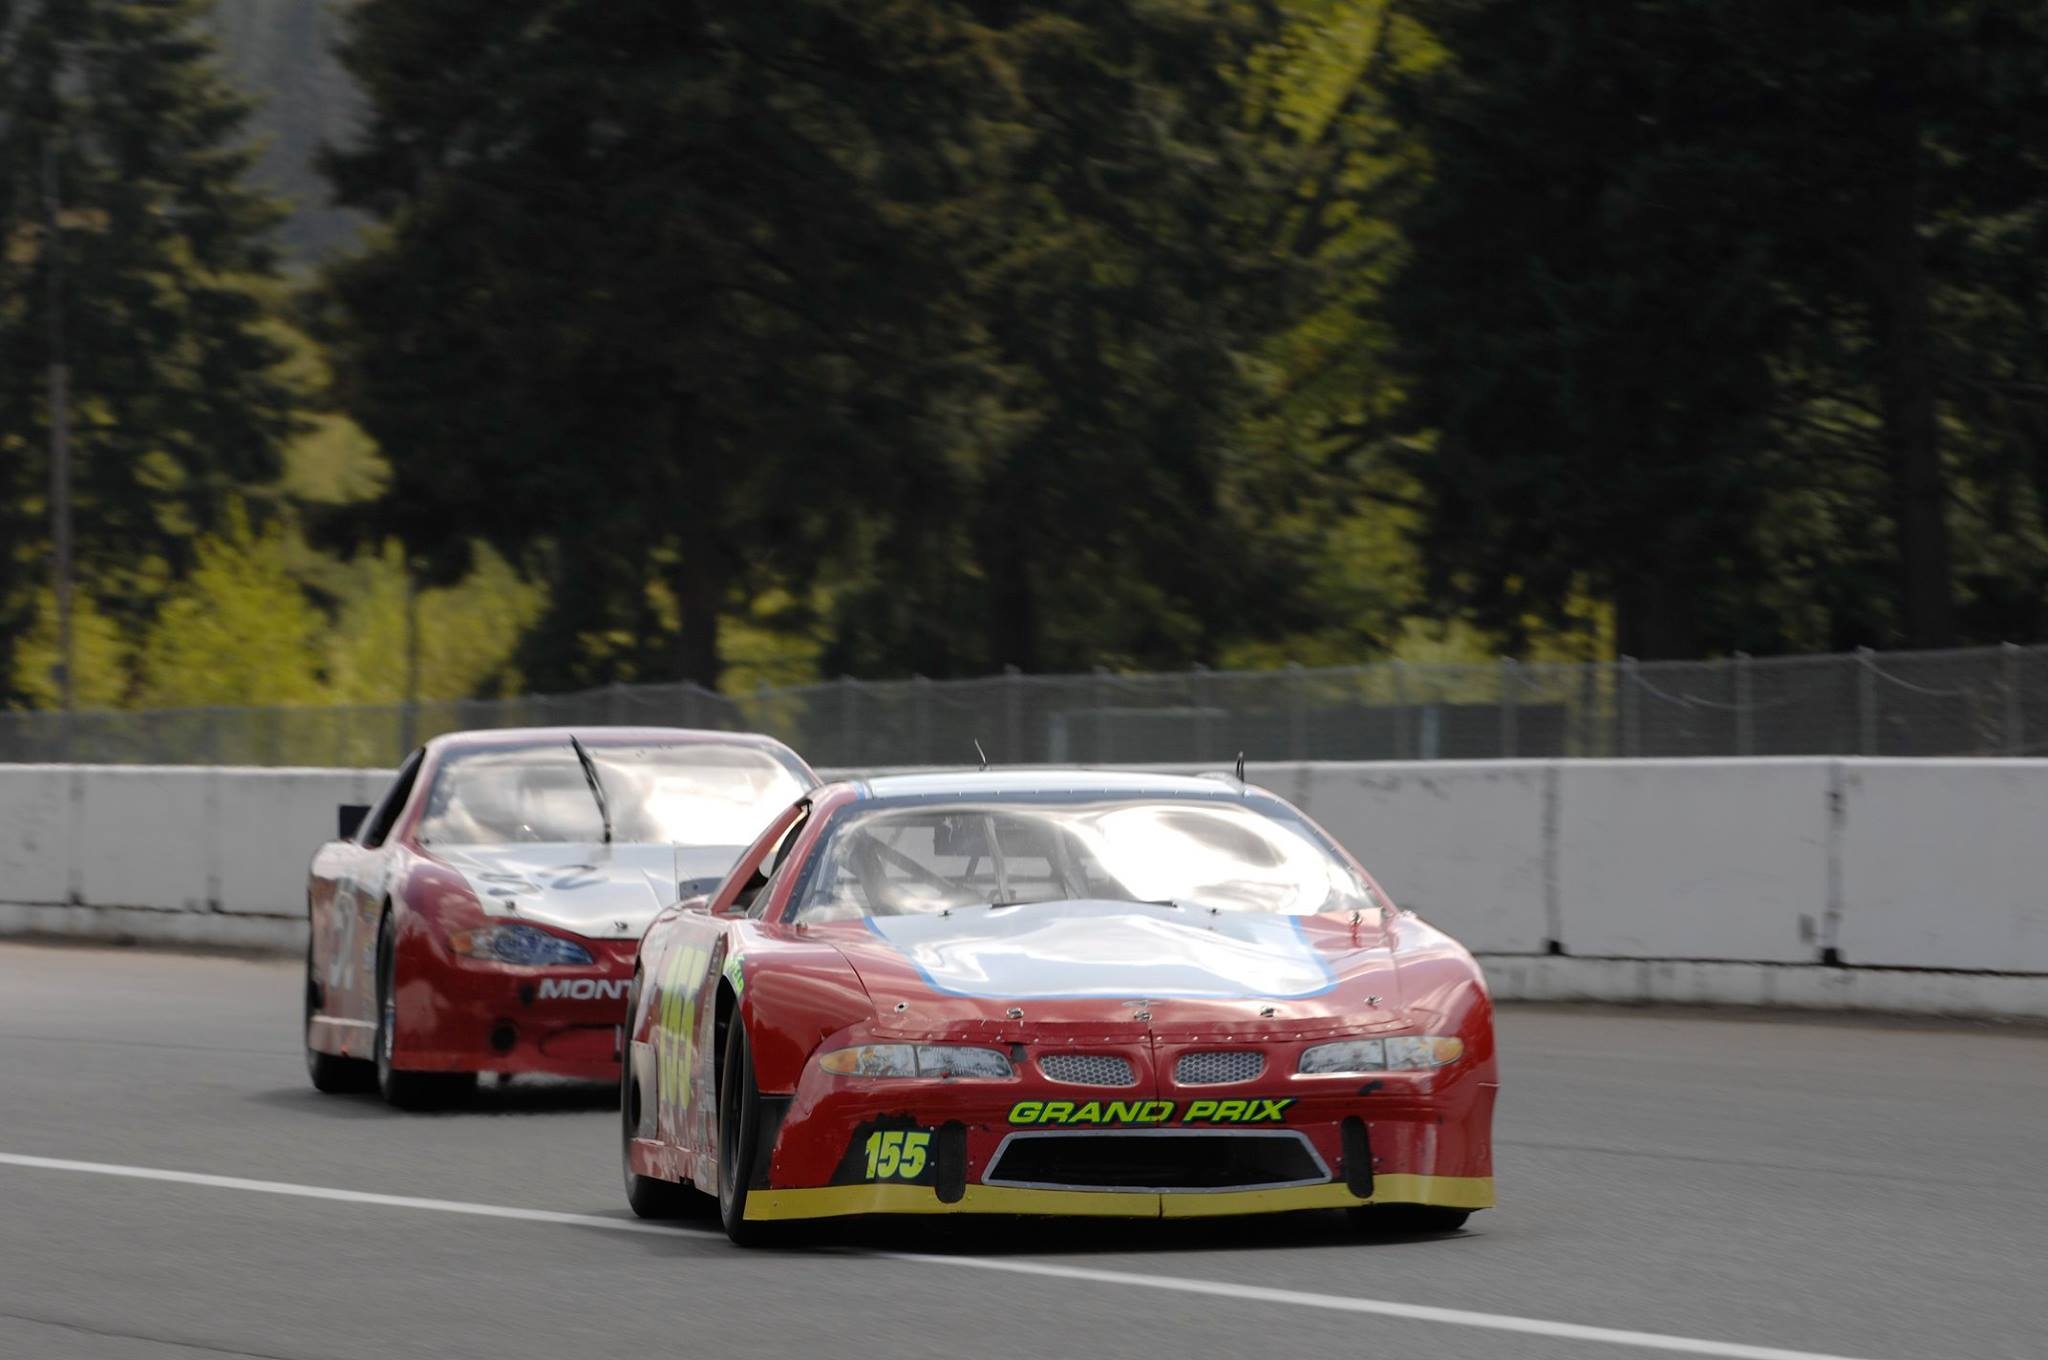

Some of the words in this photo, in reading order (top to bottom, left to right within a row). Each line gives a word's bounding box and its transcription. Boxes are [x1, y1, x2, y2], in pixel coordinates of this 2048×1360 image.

[1007, 1100, 1172, 1125] GRAND
[1182, 1098, 1293, 1123] PRIX
[864, 1130, 931, 1180] 155
